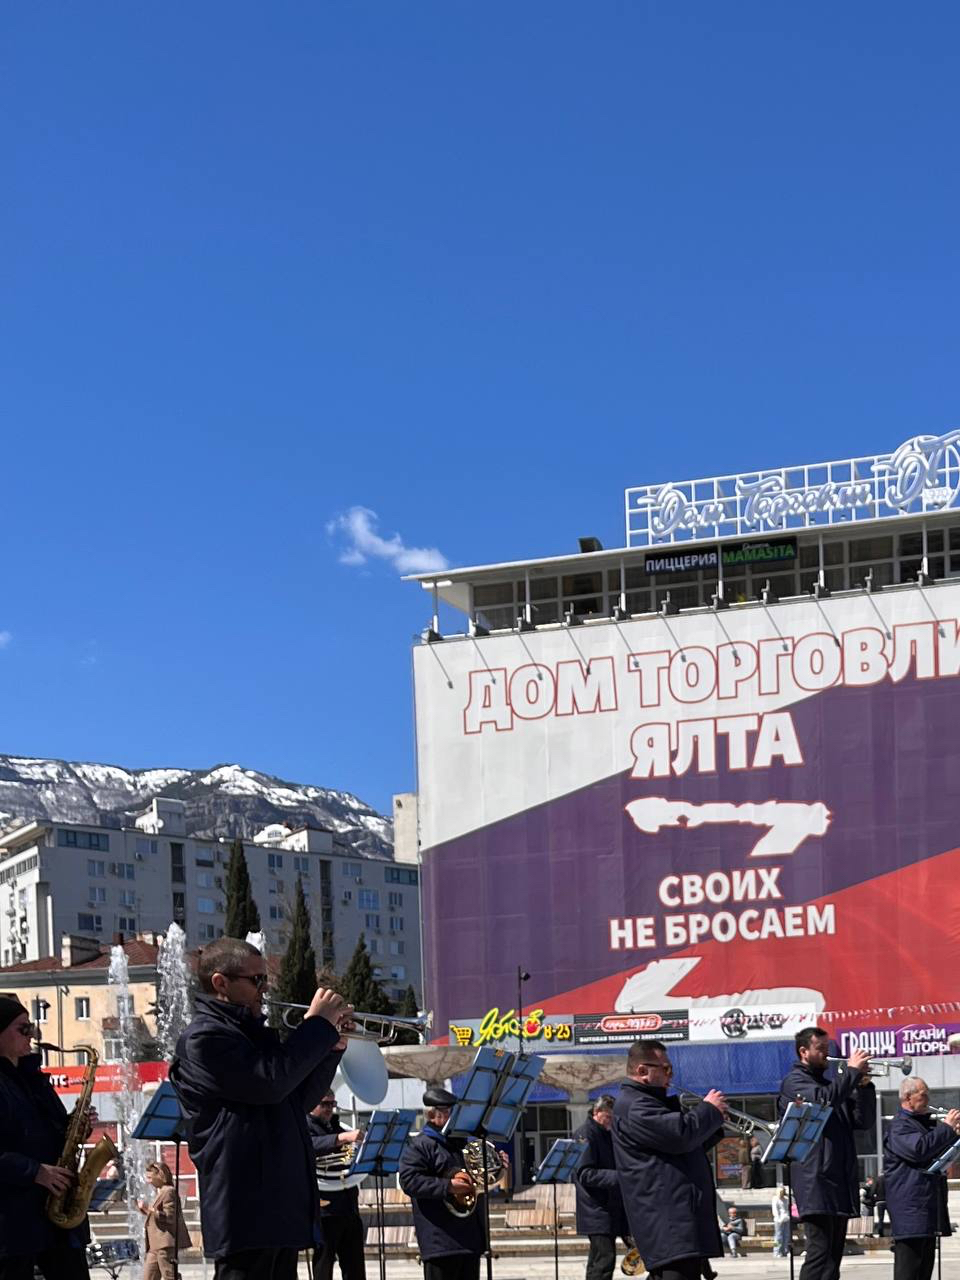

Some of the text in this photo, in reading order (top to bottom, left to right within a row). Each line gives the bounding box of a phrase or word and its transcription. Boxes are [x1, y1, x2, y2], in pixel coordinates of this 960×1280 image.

[645, 552, 717, 572] ПИЦЦЕРИЯ
[723, 544, 794, 563] MAMASITA
[464, 656, 618, 734] ДОМ
[630, 712, 803, 779] ЯЛТА
[658, 866, 784, 907] СВОИХ
[608, 903, 836, 951] НЕ БРОСАЕМ
[902, 1028, 947, 1041] ТКАНИ
[902, 1040, 951, 1054] ШТОРЫ
[50, 1075, 67, 1086] ТС
